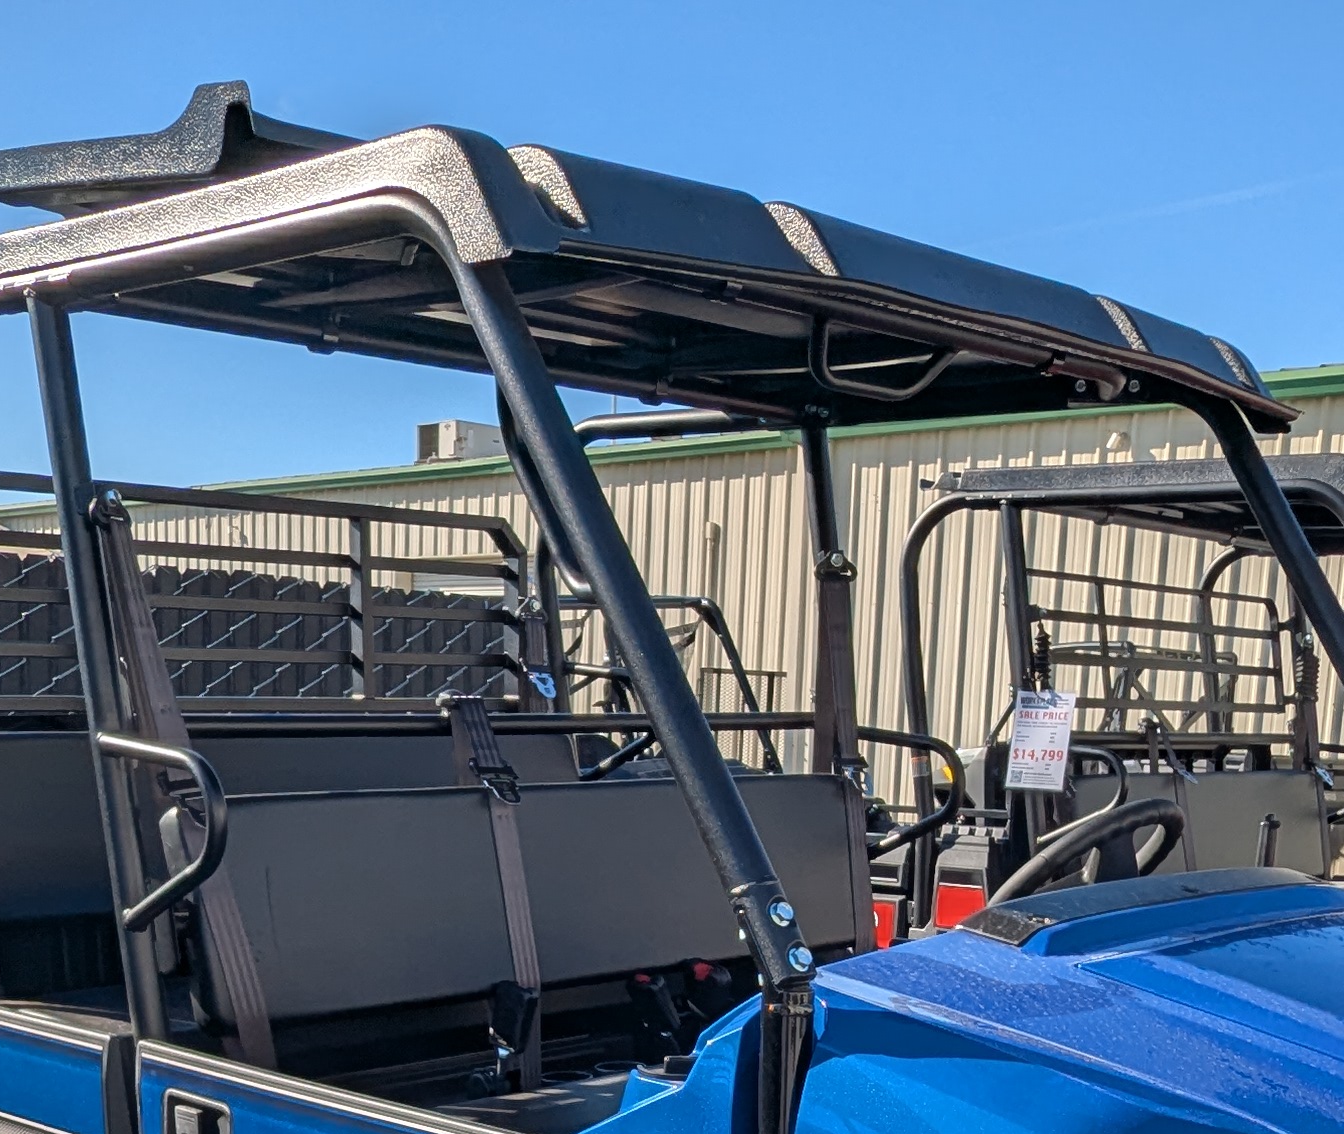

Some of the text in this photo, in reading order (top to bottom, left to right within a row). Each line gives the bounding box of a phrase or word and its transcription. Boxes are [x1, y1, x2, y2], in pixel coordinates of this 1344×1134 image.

[1019, 710, 1069, 721] SALE PRICE
[1012, 748, 1064, 762] $14,799
